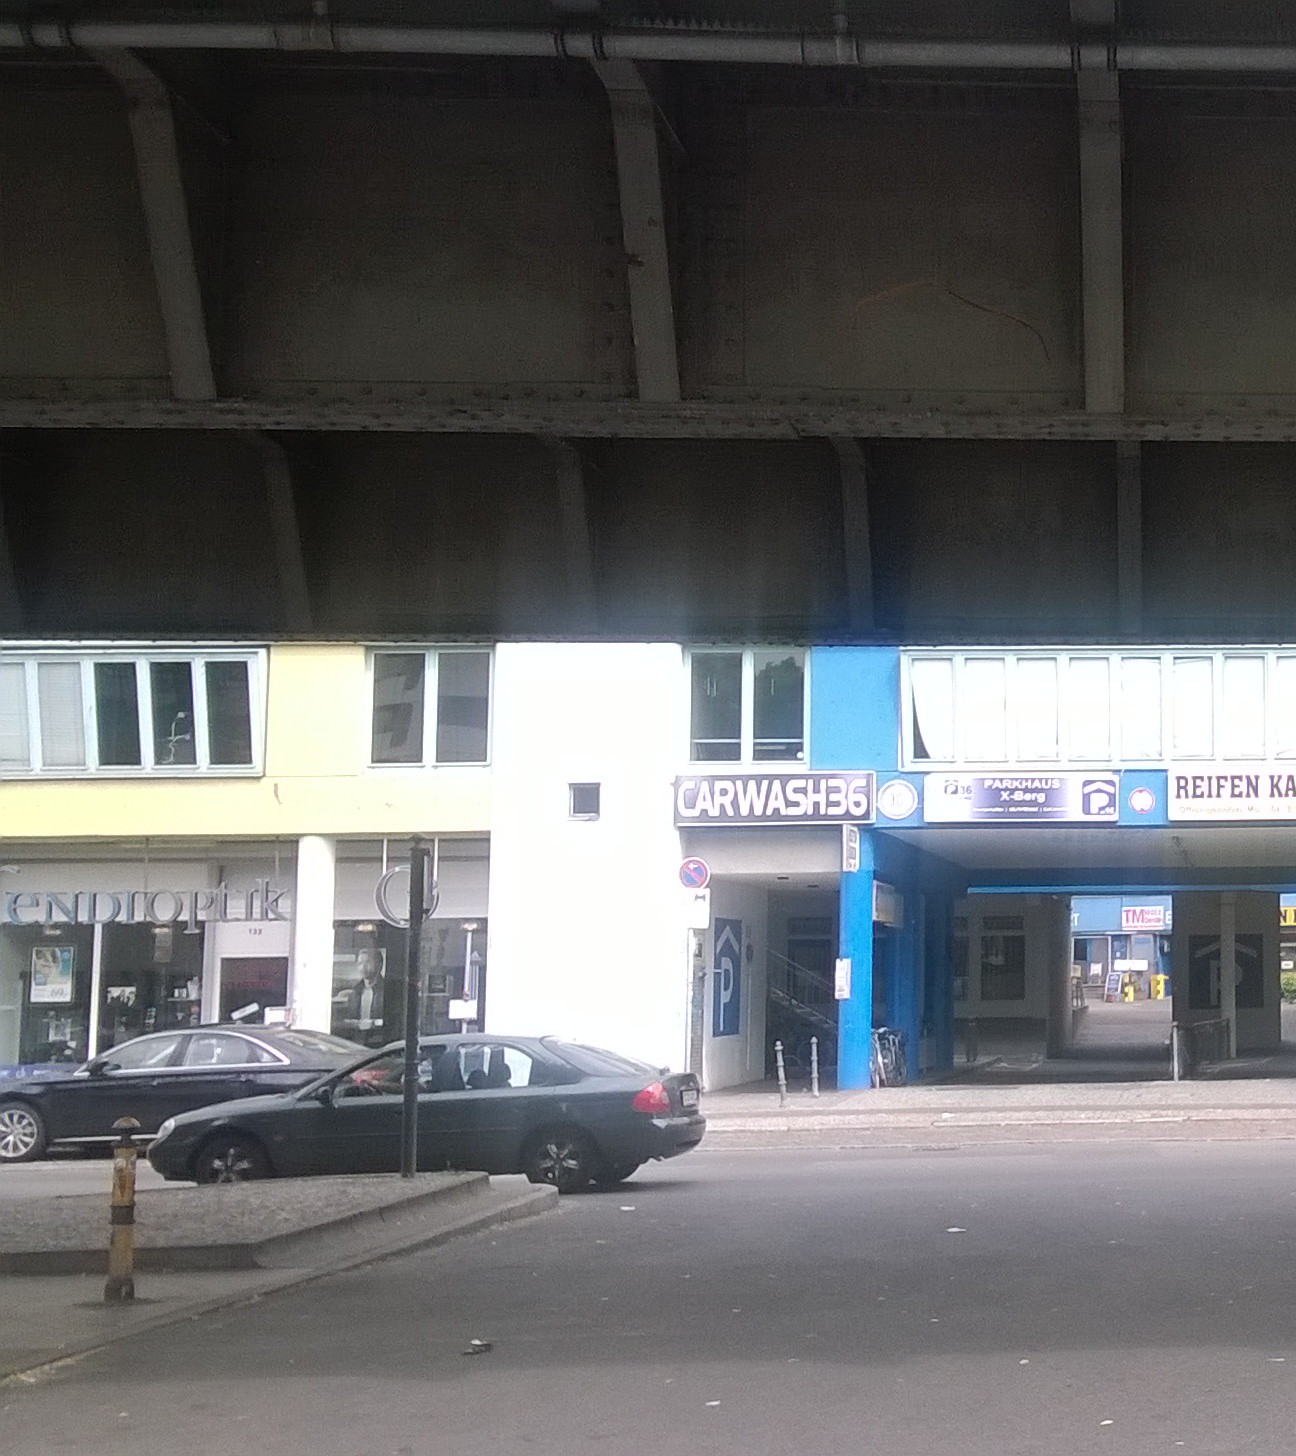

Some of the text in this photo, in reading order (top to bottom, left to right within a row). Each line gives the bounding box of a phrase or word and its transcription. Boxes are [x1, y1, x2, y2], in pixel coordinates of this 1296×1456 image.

[983, 778, 1061, 790] PARKHAUS
[1175, 775, 1260, 799] REIFEN
[676, 778, 868, 817] CARWASH36
[999, 791, 1047, 803] X-Berg
[1122, 909, 1145, 924] TM
